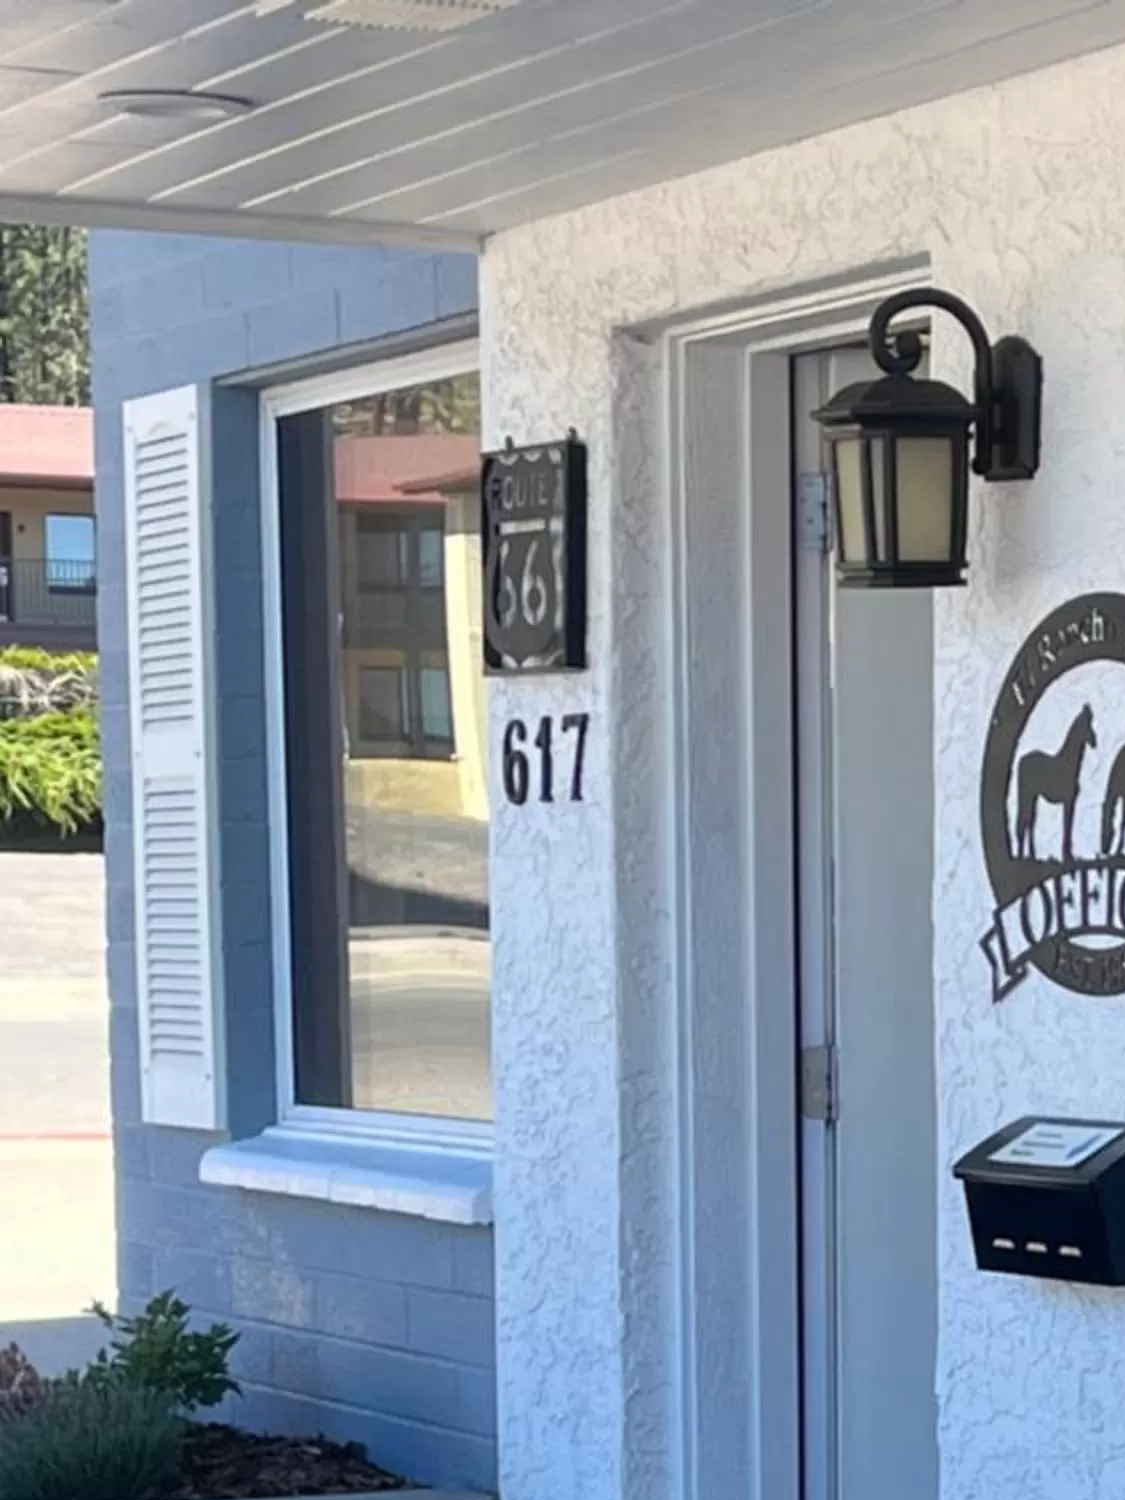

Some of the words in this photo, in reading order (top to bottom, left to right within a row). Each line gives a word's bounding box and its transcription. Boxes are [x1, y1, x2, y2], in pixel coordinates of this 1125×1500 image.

[491, 471, 549, 510] ROUTE
[492, 540, 547, 628] 66
[504, 713, 590, 805] 617
